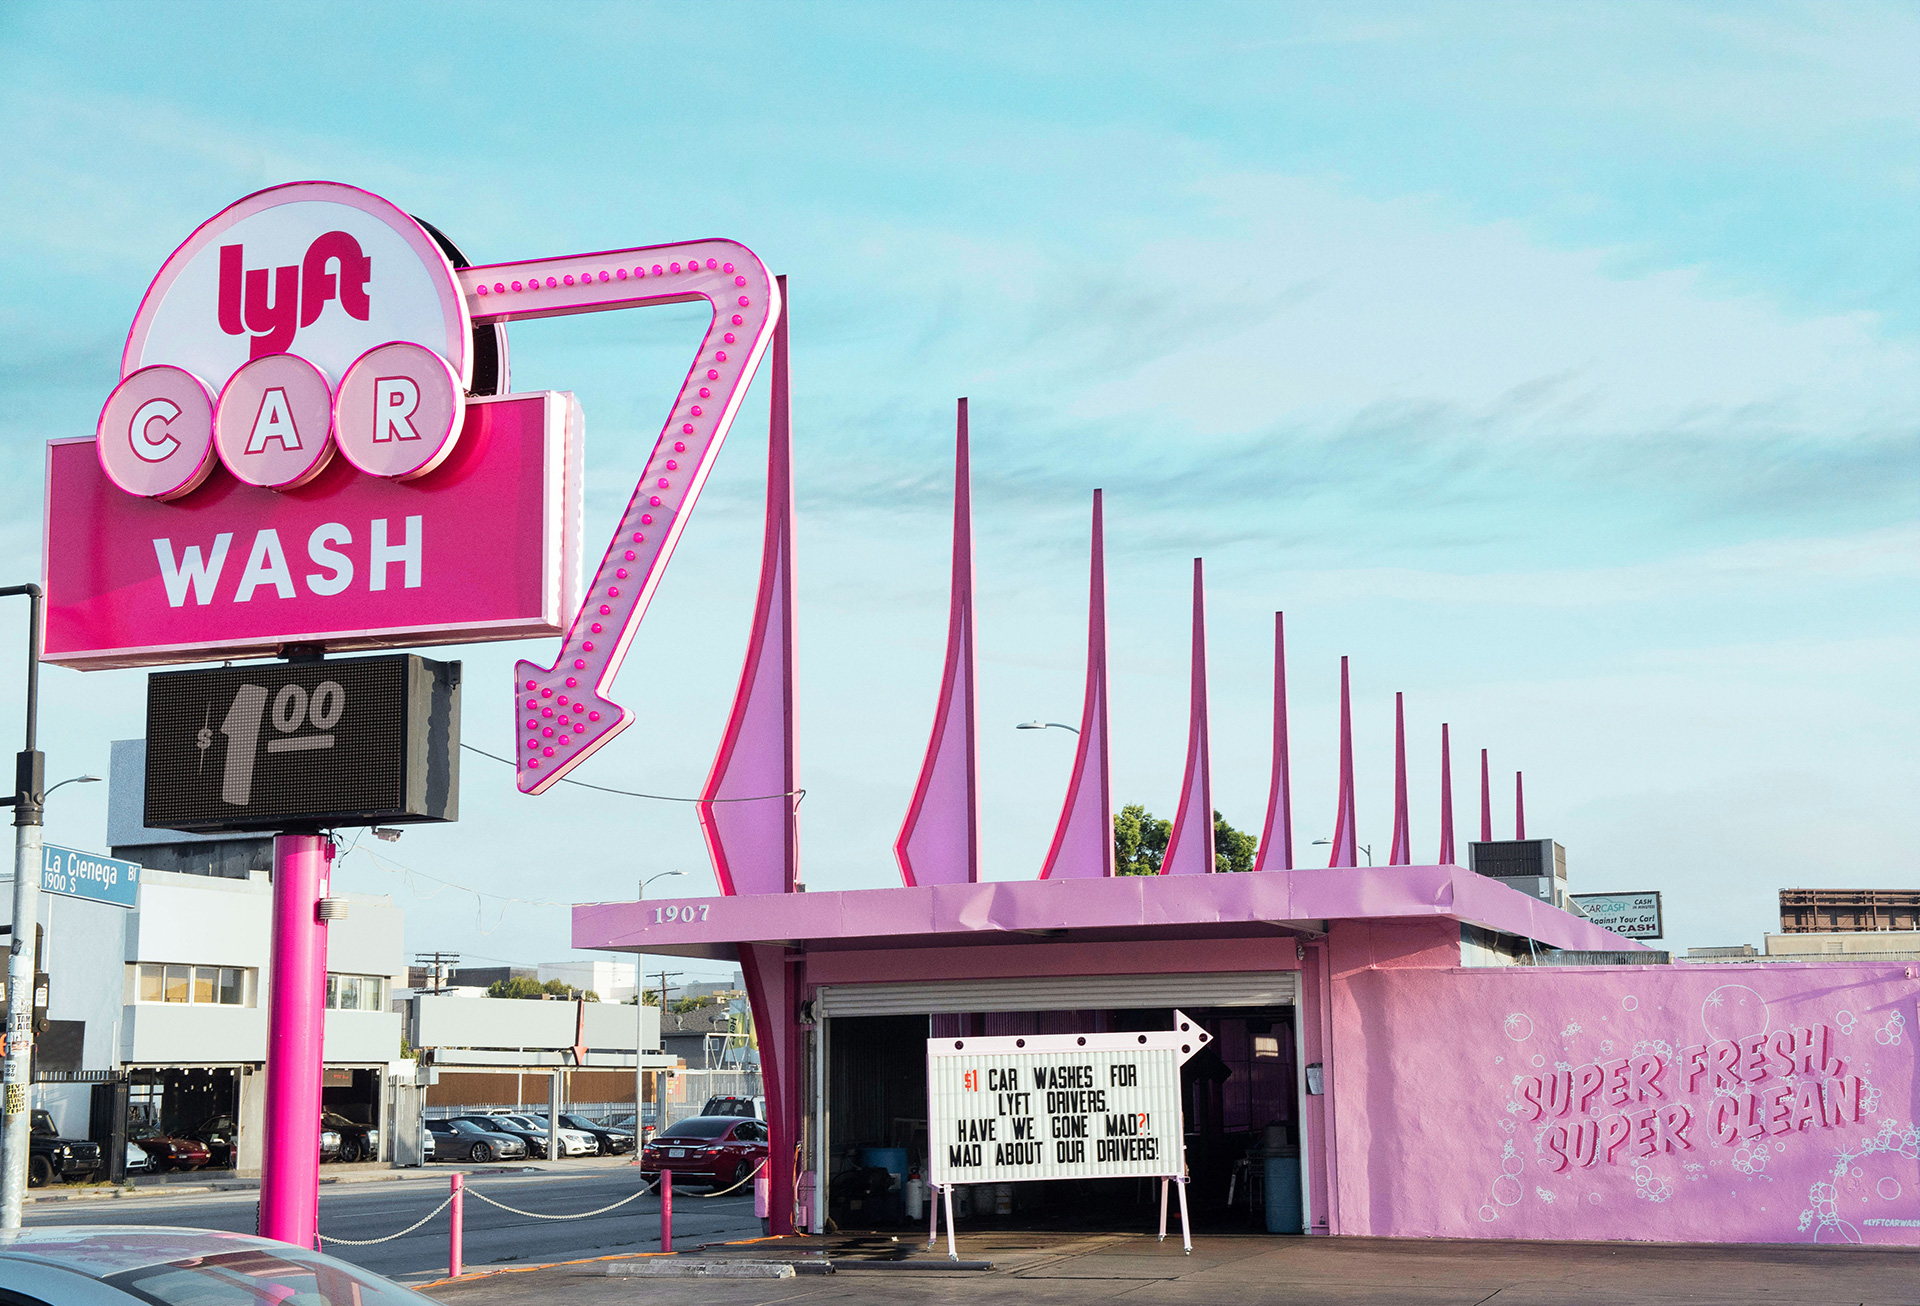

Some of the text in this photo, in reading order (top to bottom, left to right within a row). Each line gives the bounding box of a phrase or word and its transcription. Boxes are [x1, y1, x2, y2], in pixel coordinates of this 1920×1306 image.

[218, 230, 371, 359] lyft
[128, 376, 421, 463] CAR
[152, 515, 422, 608] WASH
[45, 848, 61, 873] La
[68, 853, 118, 890] Cienega
[45, 872, 76, 893] 1900 S
[654, 905, 709, 924] 1907
[964, 1064, 1137, 1092] $1 CAR WASHES FOR
[1515, 1023, 1844, 1124] SUPER FRESH,
[998, 1089, 1110, 1116] LYFT DRIVERS.
[958, 1113, 1151, 1142] HAVE WE GONE MAD?!
[1537, 1075, 1864, 1174] SUPER CLEAN
[950, 1138, 1160, 1168] MAD ABOUT OUR DRIVERS!
